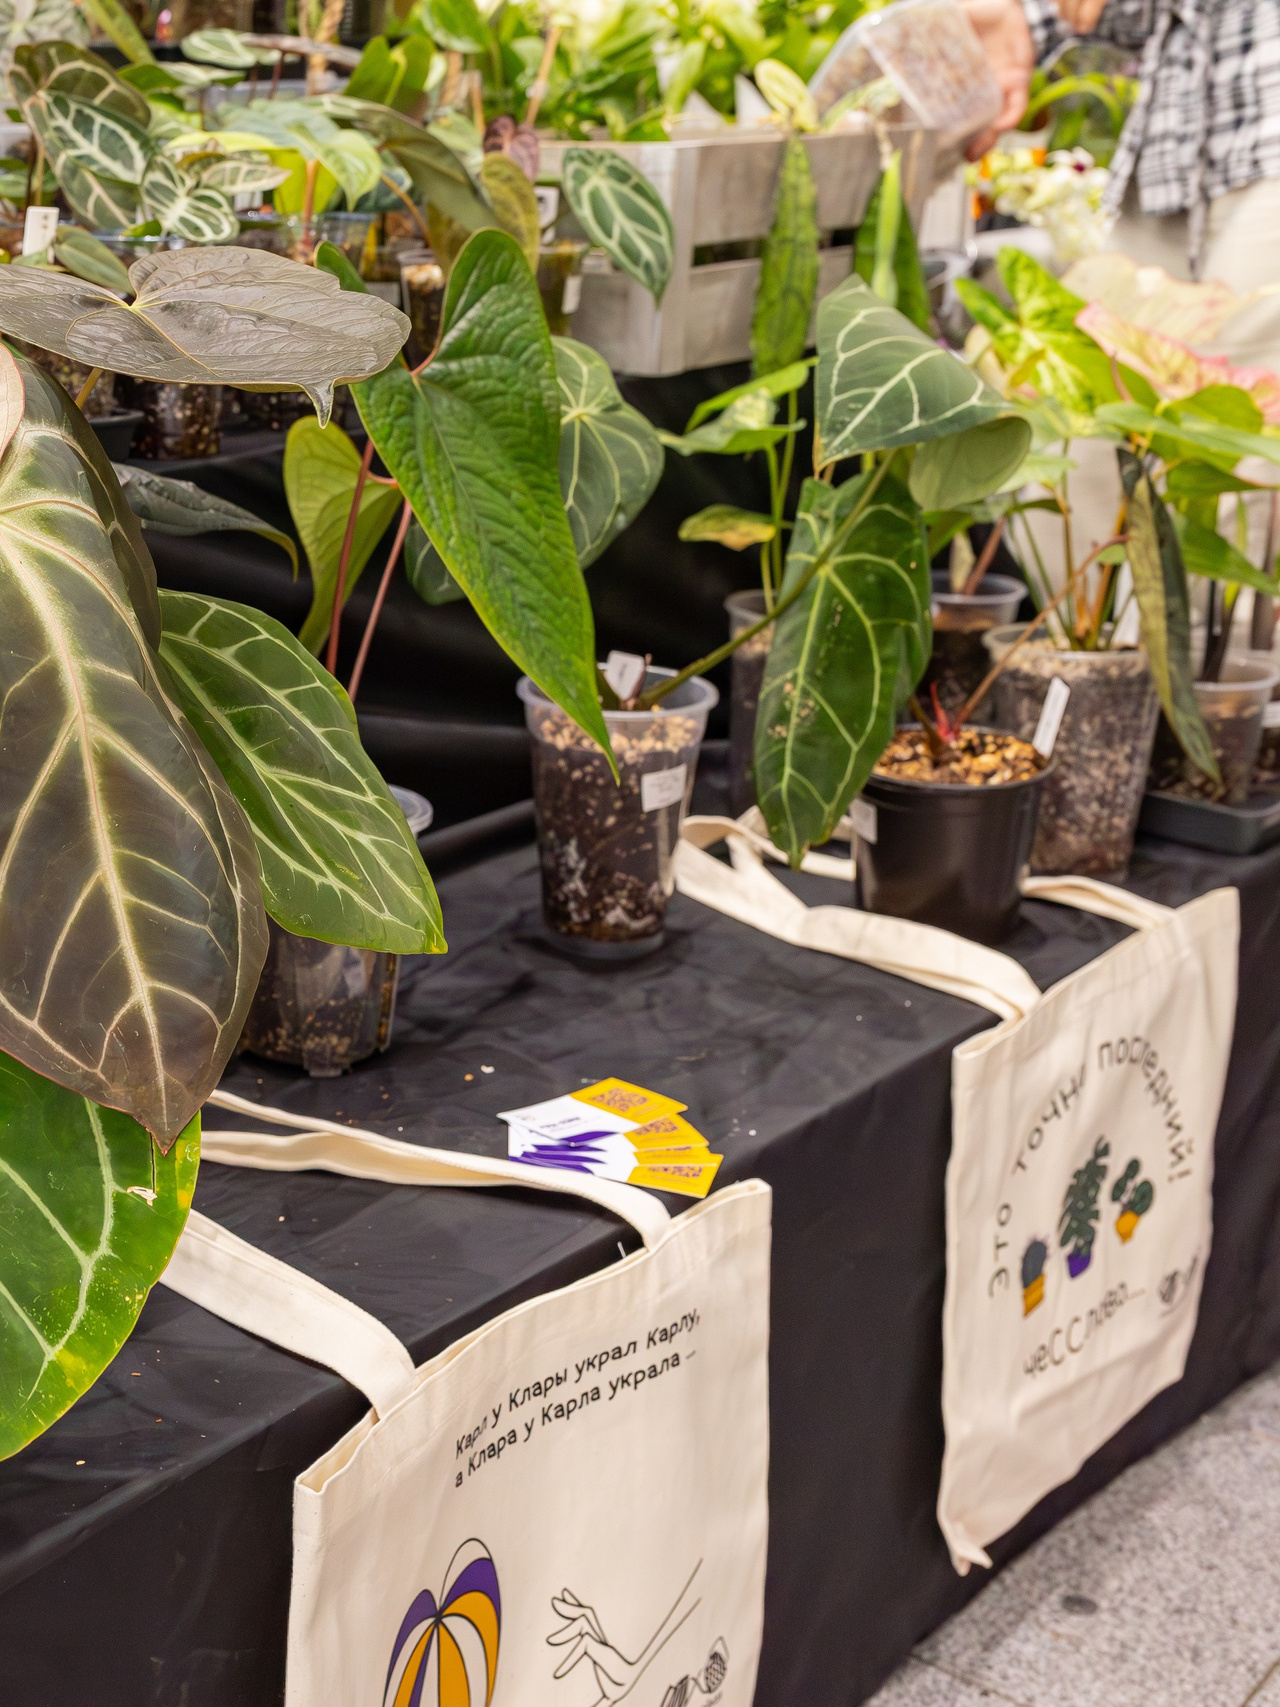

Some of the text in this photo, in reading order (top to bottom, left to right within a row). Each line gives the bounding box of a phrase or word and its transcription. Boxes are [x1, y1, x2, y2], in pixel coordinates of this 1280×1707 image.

[454, 1471, 463, 1488] а
[468, 1429, 518, 1477] Клара
[523, 1417, 535, 1442] у
[541, 1386, 601, 1426] Карла
[608, 1353, 681, 1400] украла
[455, 1308, 701, 1460] Карл у Клары украл Карлу,
